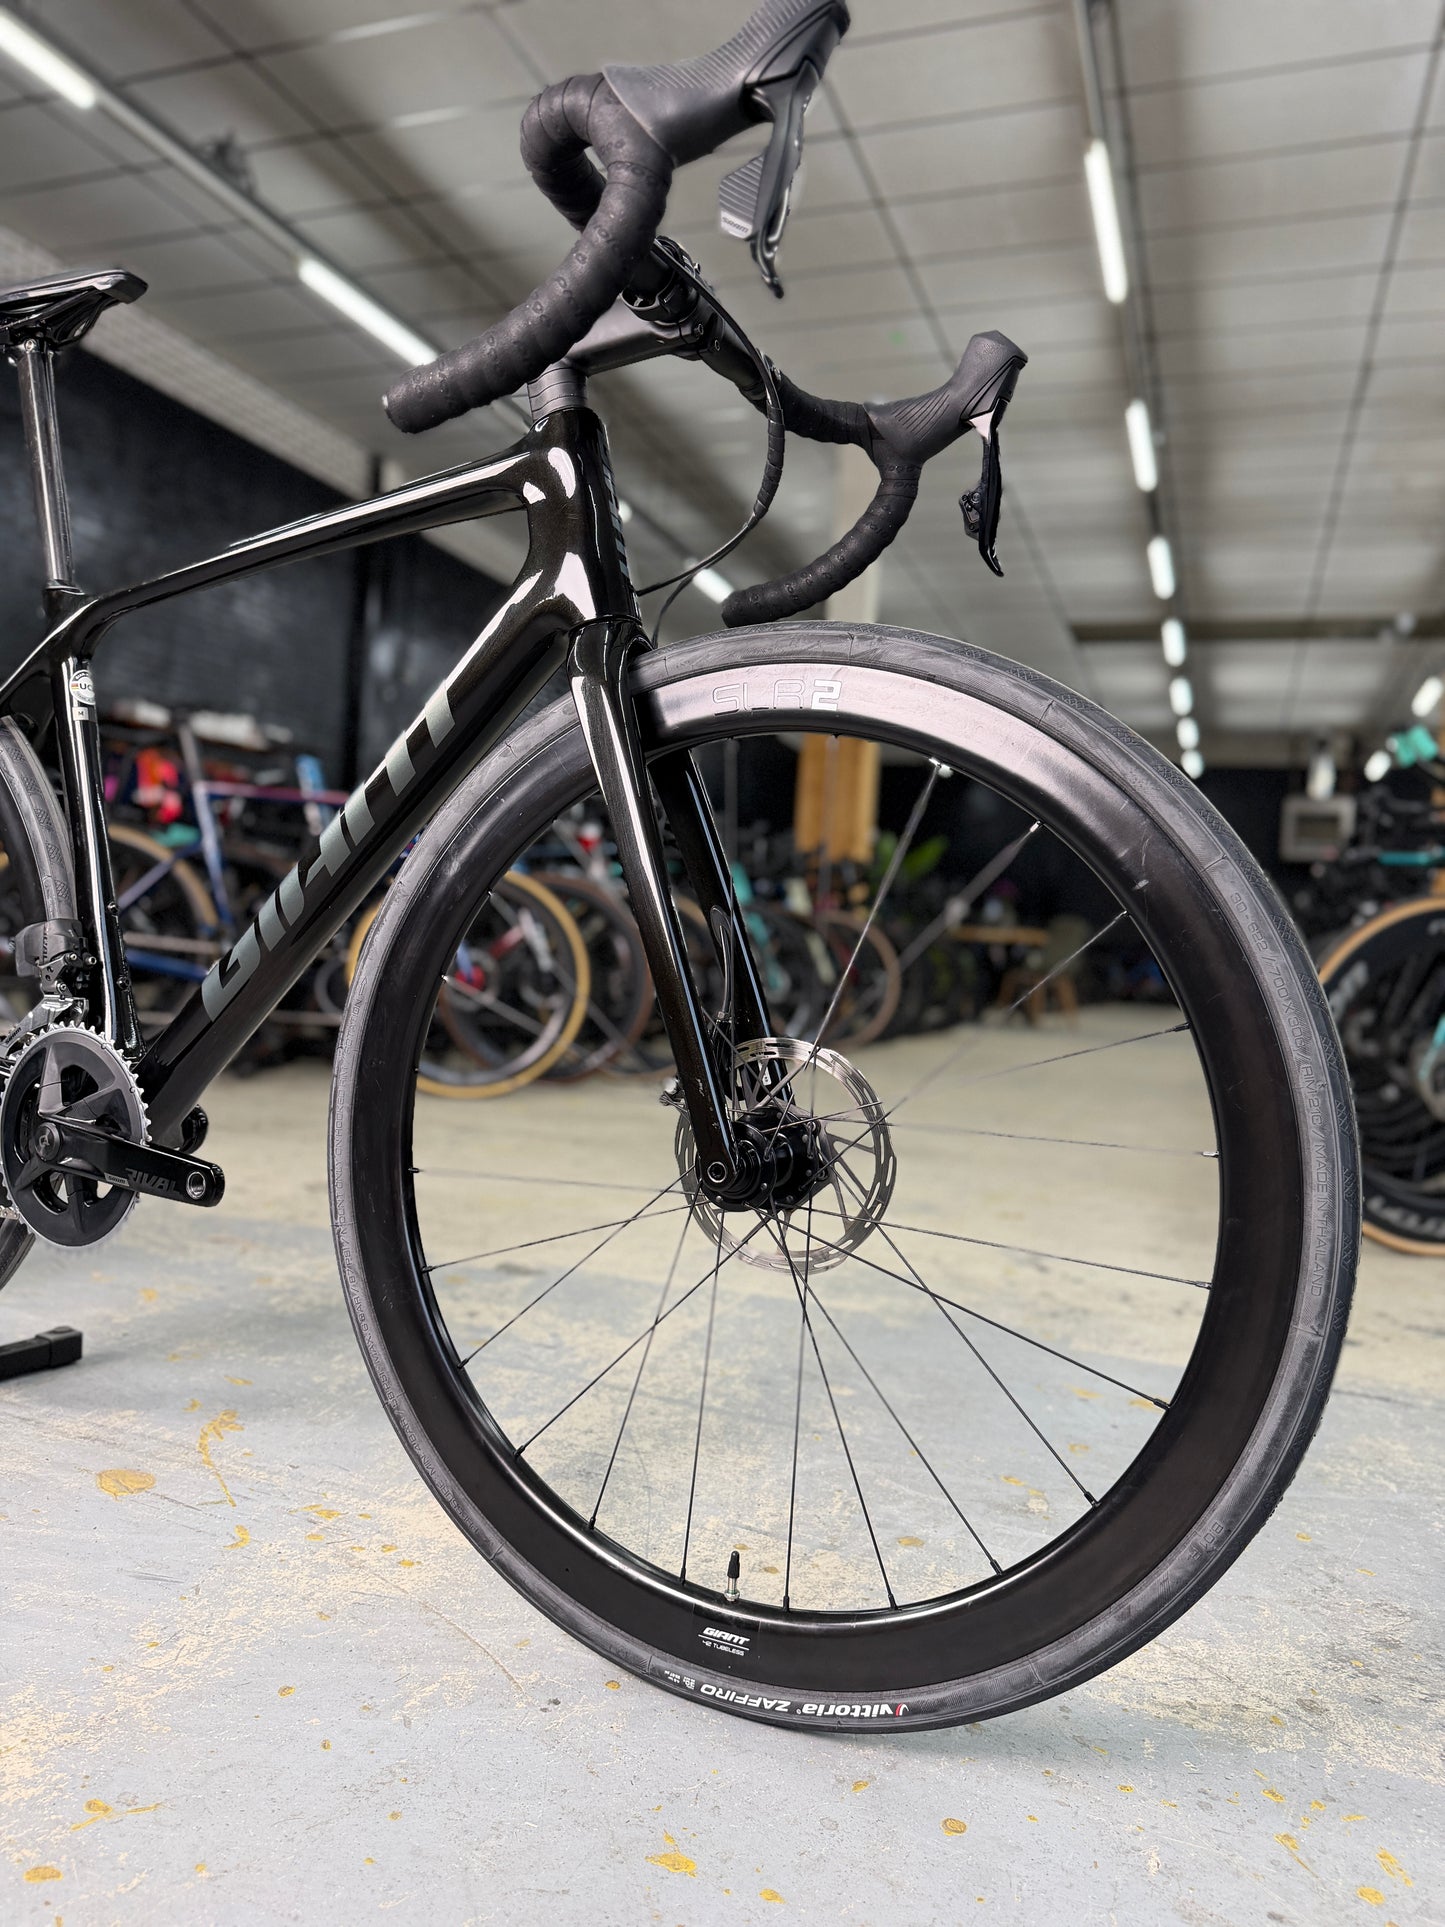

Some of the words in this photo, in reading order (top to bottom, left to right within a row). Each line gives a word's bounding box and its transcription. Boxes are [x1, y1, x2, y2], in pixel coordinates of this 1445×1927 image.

[200, 682, 457, 1022] GIANT
[1301, 1065, 1318, 1096] RIM
[125, 1167, 181, 1195] RIVAL
[1314, 1142, 1328, 1193] MADE
[1316, 1197, 1329, 1212] IN
[1310, 1213, 1329, 1298] THAILAND
[702, 1626, 751, 1645] GIANT
[712, 1642, 745, 1657] TUBELESS
[700, 1683, 792, 1712] ZAFFIRO
